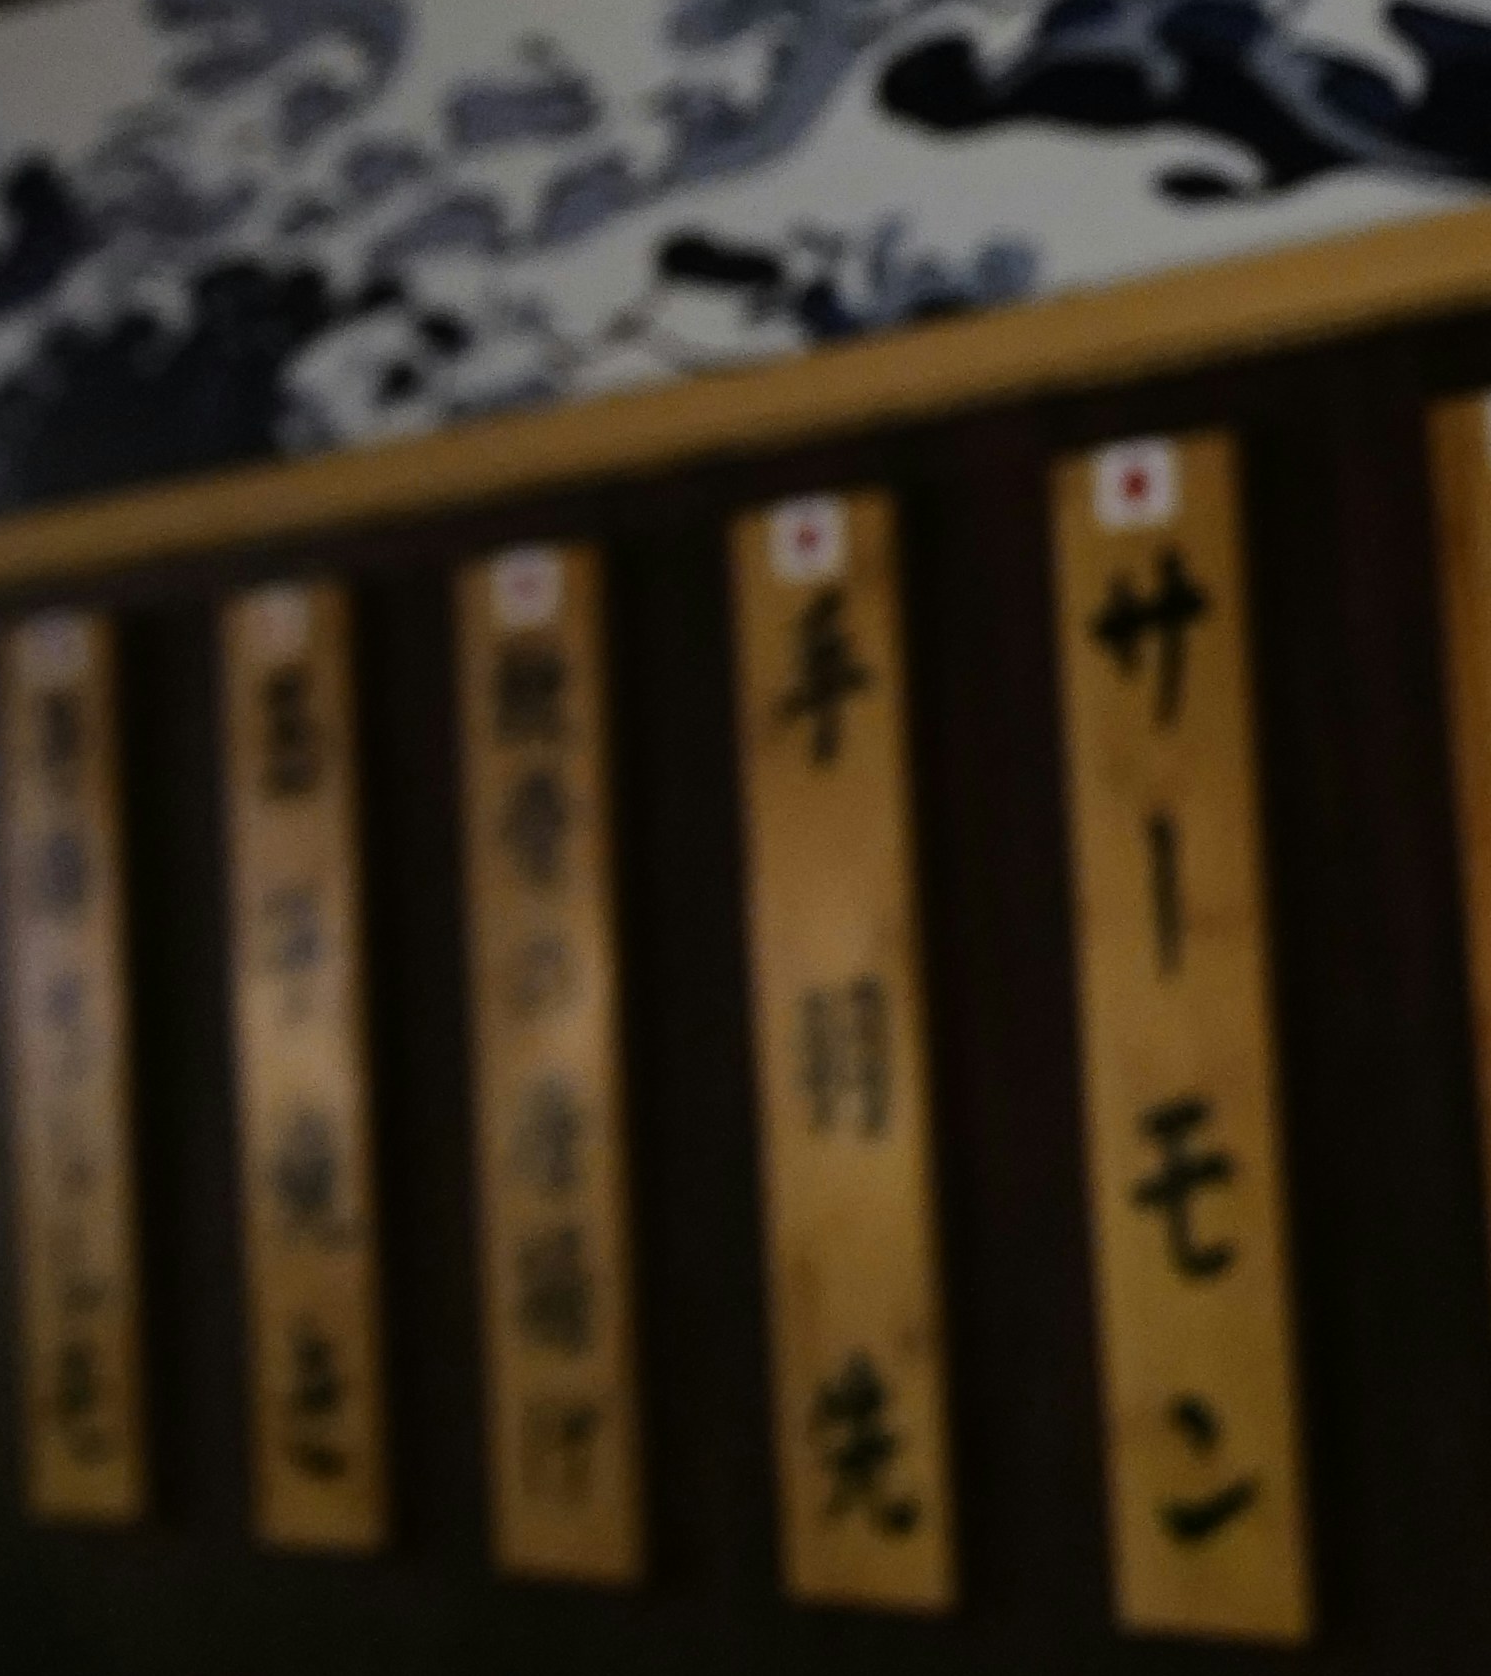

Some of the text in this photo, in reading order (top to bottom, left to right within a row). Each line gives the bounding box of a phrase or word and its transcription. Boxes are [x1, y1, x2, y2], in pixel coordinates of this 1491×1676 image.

[779, 586, 921, 1542] 手羽先
[1093, 545, 1259, 1546] サーモン
